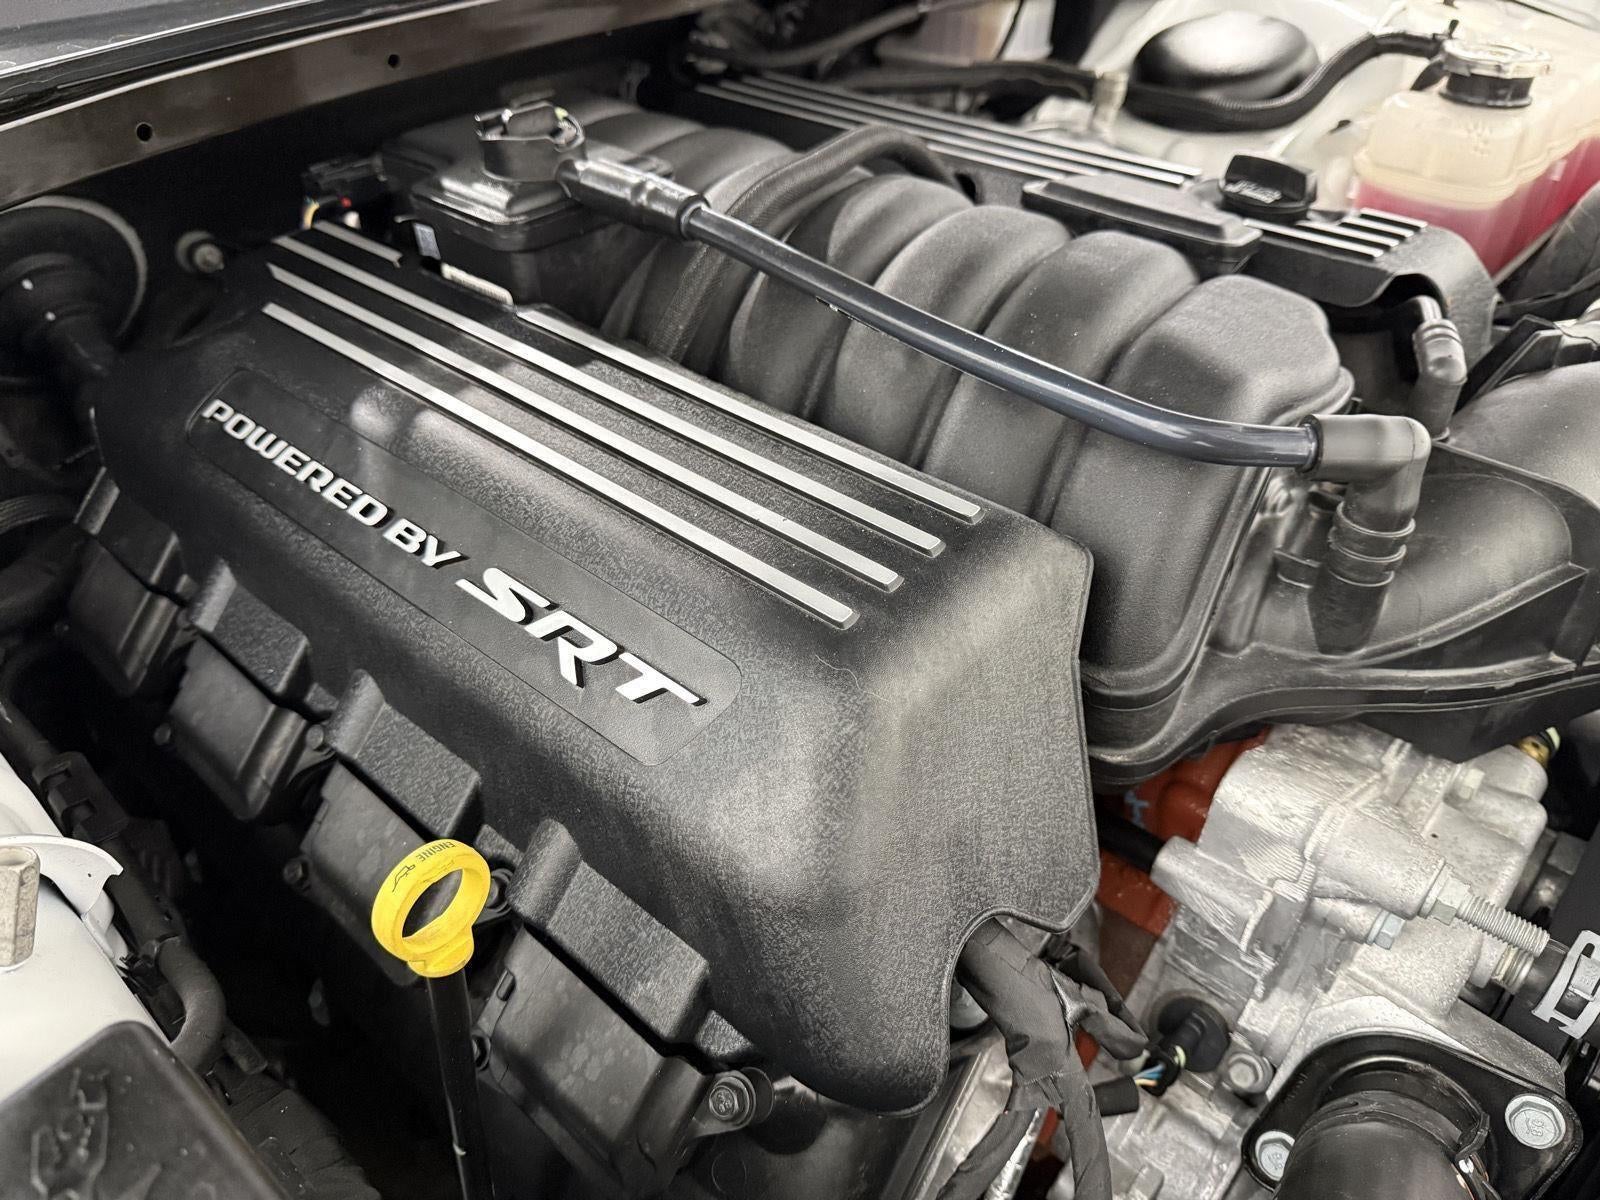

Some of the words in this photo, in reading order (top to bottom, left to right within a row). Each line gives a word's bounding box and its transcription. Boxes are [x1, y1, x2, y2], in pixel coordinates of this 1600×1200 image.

[202, 399, 388, 526] POWERED
[383, 518, 461, 567] BY
[455, 567, 705, 706] SRT
[416, 841, 456, 862] ENGINE
